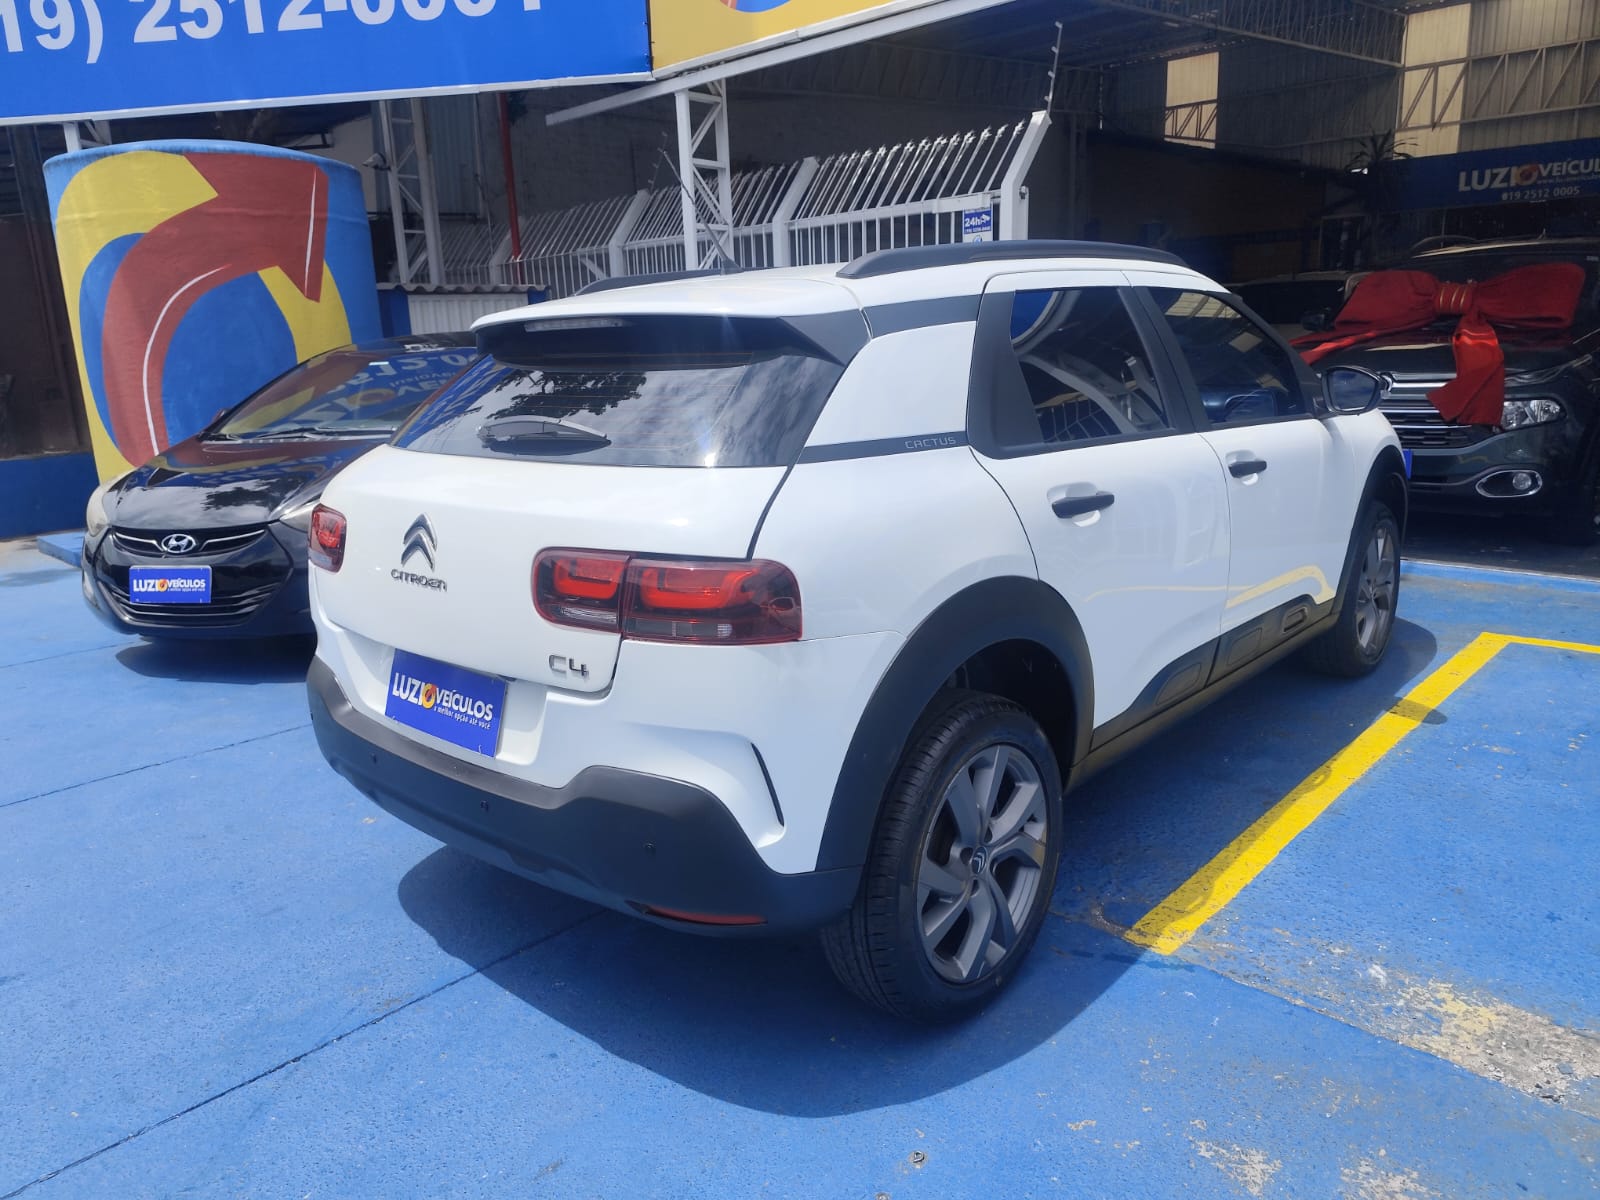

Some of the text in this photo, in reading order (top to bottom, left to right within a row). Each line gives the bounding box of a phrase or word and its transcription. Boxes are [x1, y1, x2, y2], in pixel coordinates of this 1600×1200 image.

[1524, 188, 1550, 199] 2512
[1553, 185, 1581, 197] 0005
[904, 437, 957, 449] CACTUS
[133, 578, 169, 593] LUZIO
[548, 654, 589, 679] C4
[392, 672, 494, 722] LUZIO VEÍCULOS
